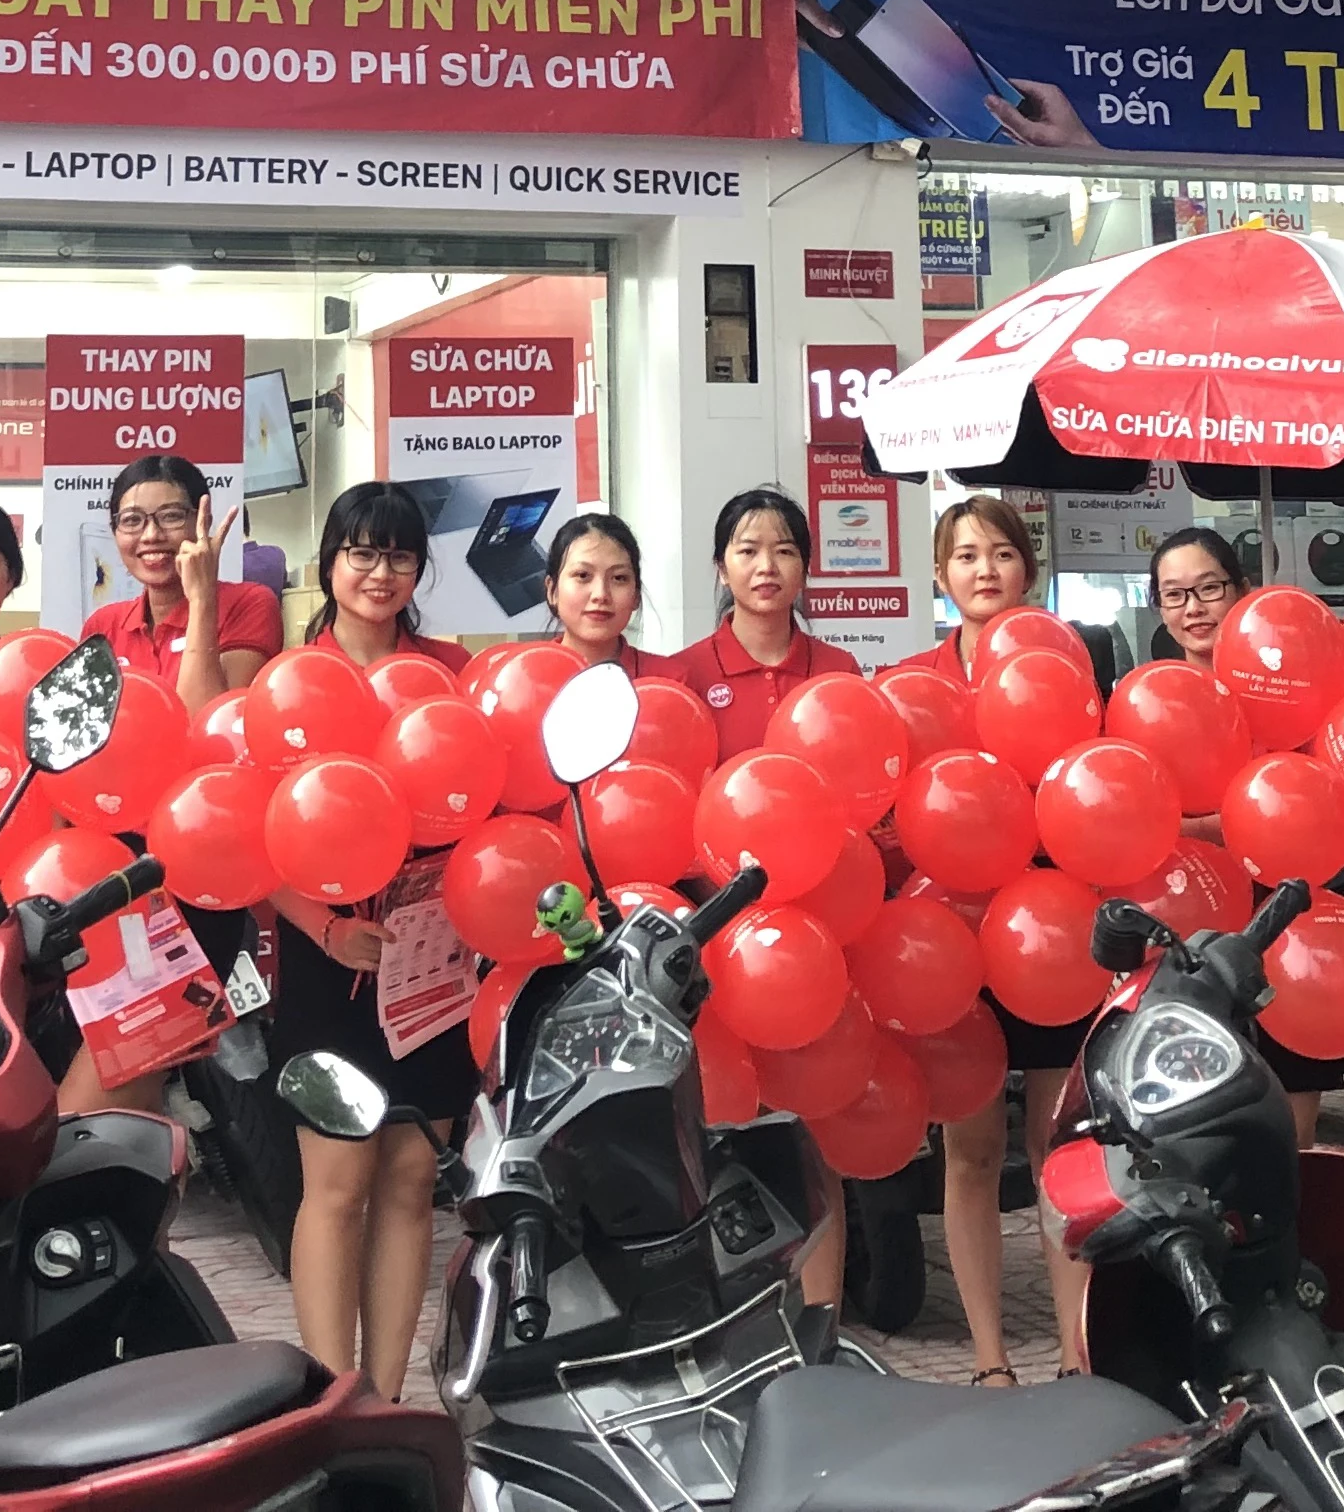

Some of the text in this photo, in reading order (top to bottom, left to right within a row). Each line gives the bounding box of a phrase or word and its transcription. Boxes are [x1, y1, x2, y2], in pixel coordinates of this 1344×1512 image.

[106, 41, 337, 85] 300.000Đ
[350, 44, 428, 86] PHÍ
[439, 42, 535, 89] SỬA
[545, 49, 676, 90] CHỮA
[1064, 44, 1194, 88] Trợ Giá
[1203, 48, 1261, 129] 4
[1097, 87, 1171, 127] Đến
[25, 151, 158, 181] LAPTOP
[183, 155, 330, 186] BATTERY
[357, 160, 483, 190] SCREEN
[508, 164, 607, 195] QUICK
[613, 169, 741, 198] SERVICE
[919, 214, 985, 244] TRIỆU
[80, 348, 212, 373] THAY PIN
[410, 342, 554, 373] SỬA CHỮA
[49, 382, 242, 416] DUNG LƯỢNG
[430, 385, 536, 409] LAPTOP
[115, 424, 177, 450] CAO
[1051, 403, 1108, 433] SỬA
[1115, 411, 1194, 440] CHỮA
[1199, 414, 1265, 448] ĐIỆN
[404, 433, 563, 455] TẶNG BALO LAPTOP
[53, 474, 104, 491] CHÍNH
[827, 536, 882, 548] mobifone
[809, 590, 901, 615] TUYỂN DỤNG
